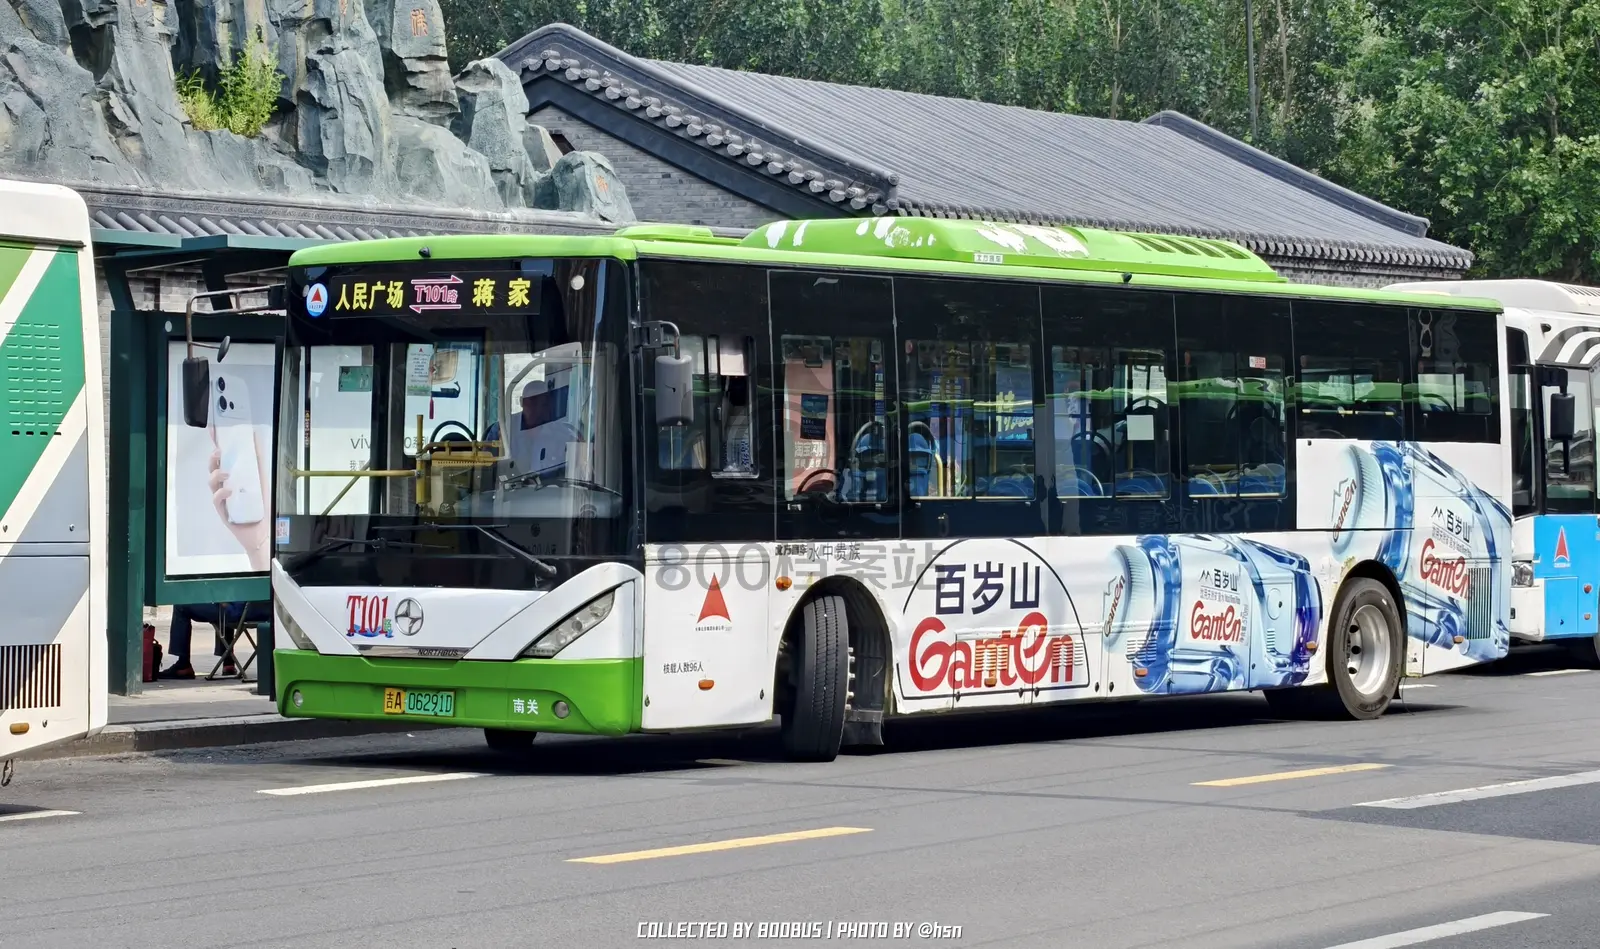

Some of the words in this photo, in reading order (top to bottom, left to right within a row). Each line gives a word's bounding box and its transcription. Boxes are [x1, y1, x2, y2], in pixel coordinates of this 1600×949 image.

[335, 281, 404, 311] 人民广场
[1447, 508, 1470, 544] 百岁山
[808, 541, 861, 562] 水中贵族
[1213, 568, 1238, 592] 百岁山
[1419, 537, 1471, 600] Ganten
[935, 561, 1041, 615] 百岁山
[1190, 599, 1242, 642] Ganten
[417, 648, 459, 658] NORTHBUS
[908, 611, 1074, 692] Ganten
[512, 698, 539, 715] 南关
